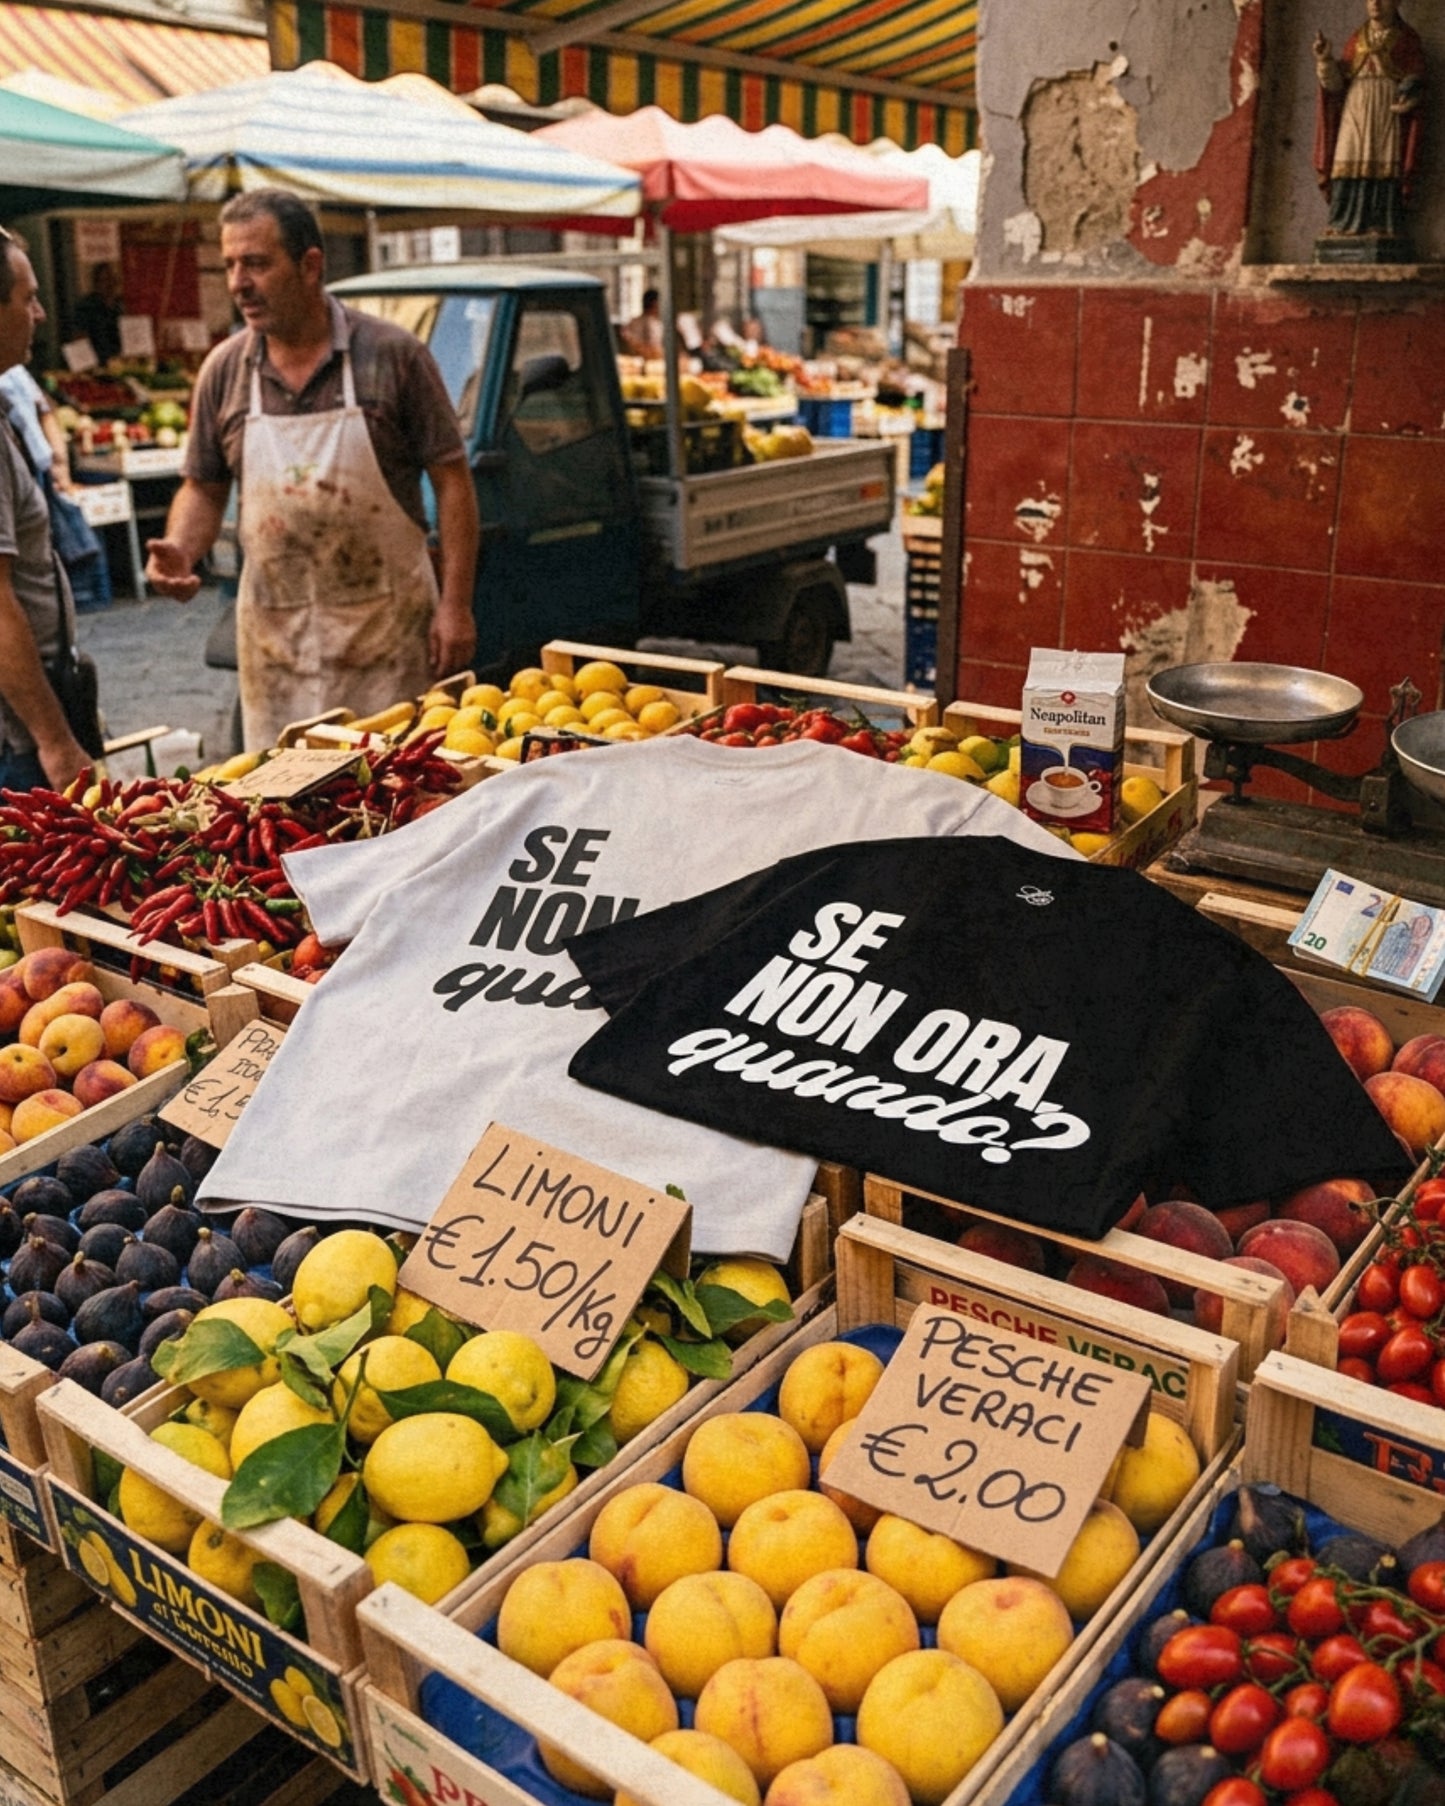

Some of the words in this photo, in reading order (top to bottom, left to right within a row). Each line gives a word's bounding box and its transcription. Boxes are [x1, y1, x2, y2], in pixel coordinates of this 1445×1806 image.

[1030, 707, 1106, 726] Neapolitan
[508, 825, 611, 887] SE
[788, 901, 906, 973] SE
[1303, 932, 1327, 951] 20
[723, 955, 908, 1055] NON
[892, 1009, 1070, 1114] ORA,
[667, 1027, 1091, 1164] quando?
[920, 1315, 1114, 1406] PESCHE
[916, 1373, 1082, 1452] VERACI
[128, 1547, 267, 1670] LIMONI
